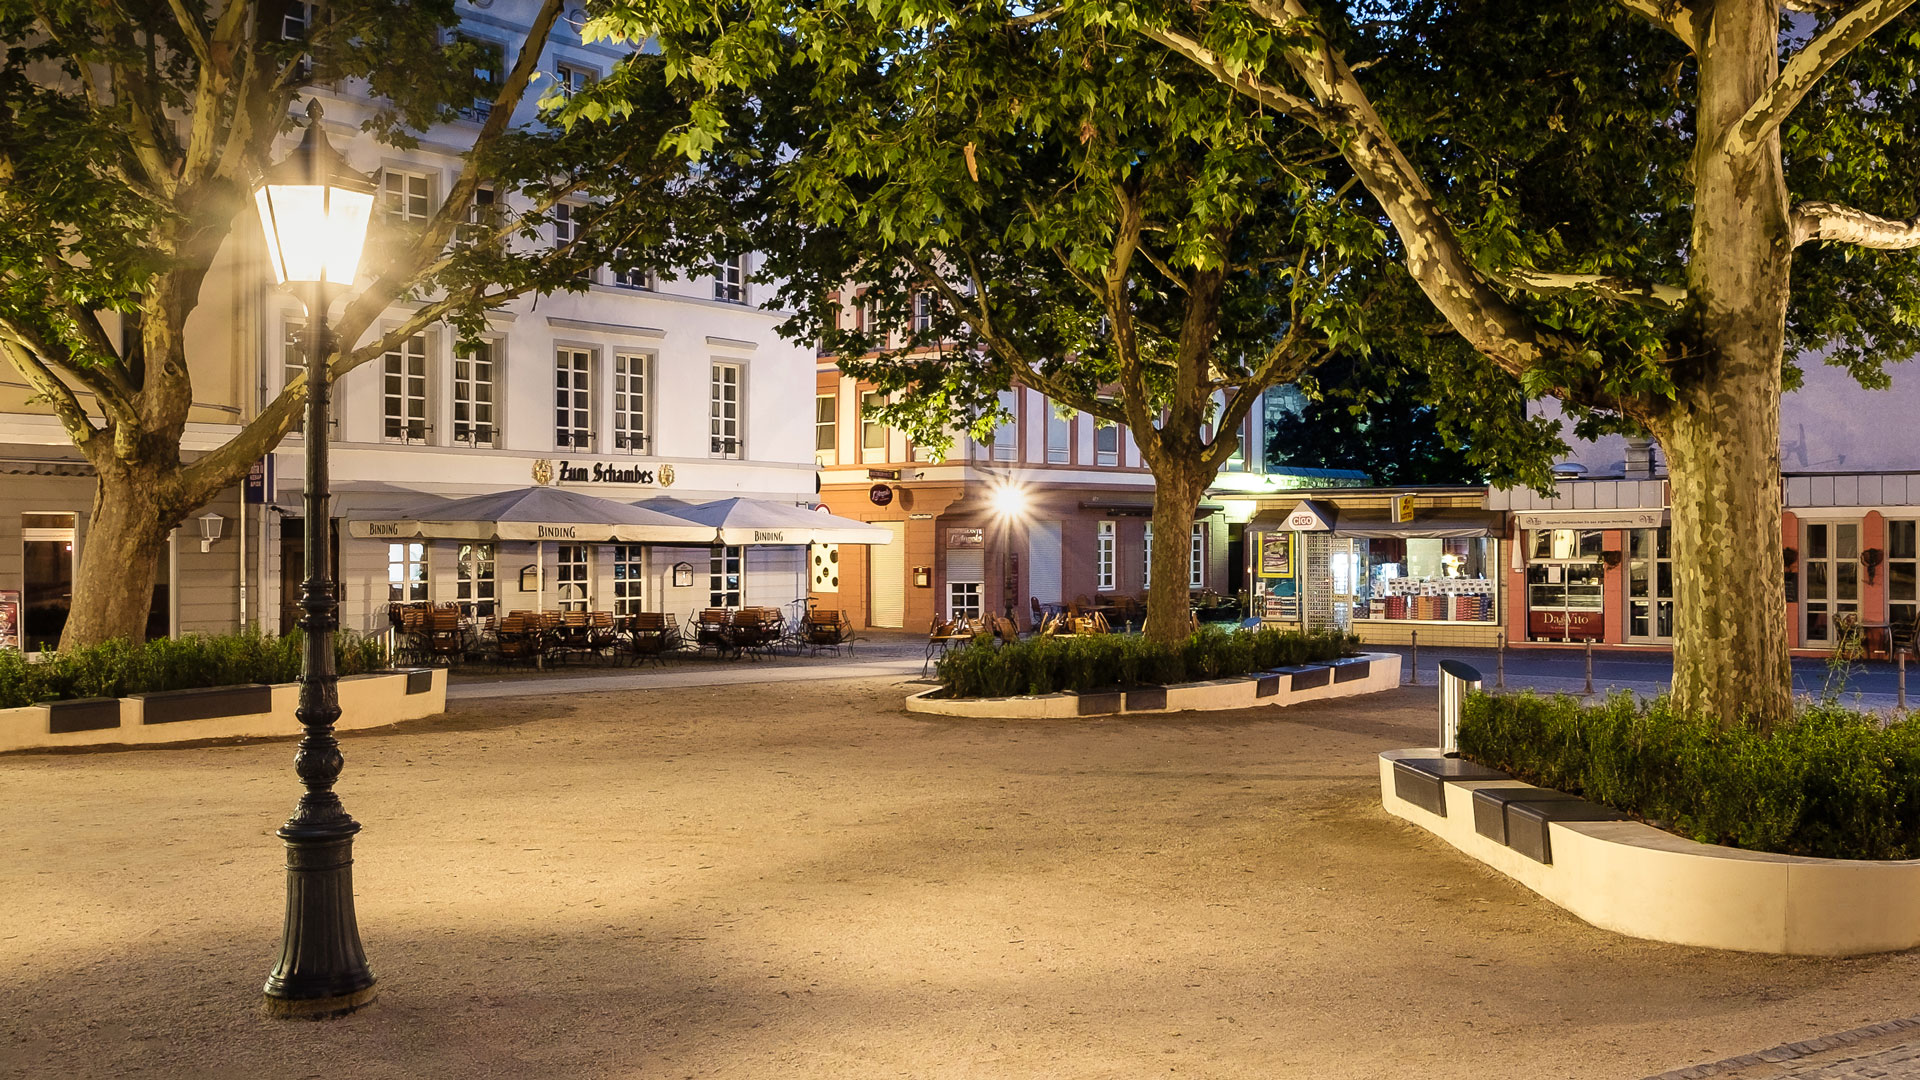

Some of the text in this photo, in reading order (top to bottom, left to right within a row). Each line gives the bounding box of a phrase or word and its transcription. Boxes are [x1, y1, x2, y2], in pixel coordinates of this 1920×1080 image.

[559, 461, 653, 484] Zum Schambes
[369, 523, 399, 535] BINDING
[537, 525, 576, 539] BINDING
[754, 530, 784, 542] BINDING
